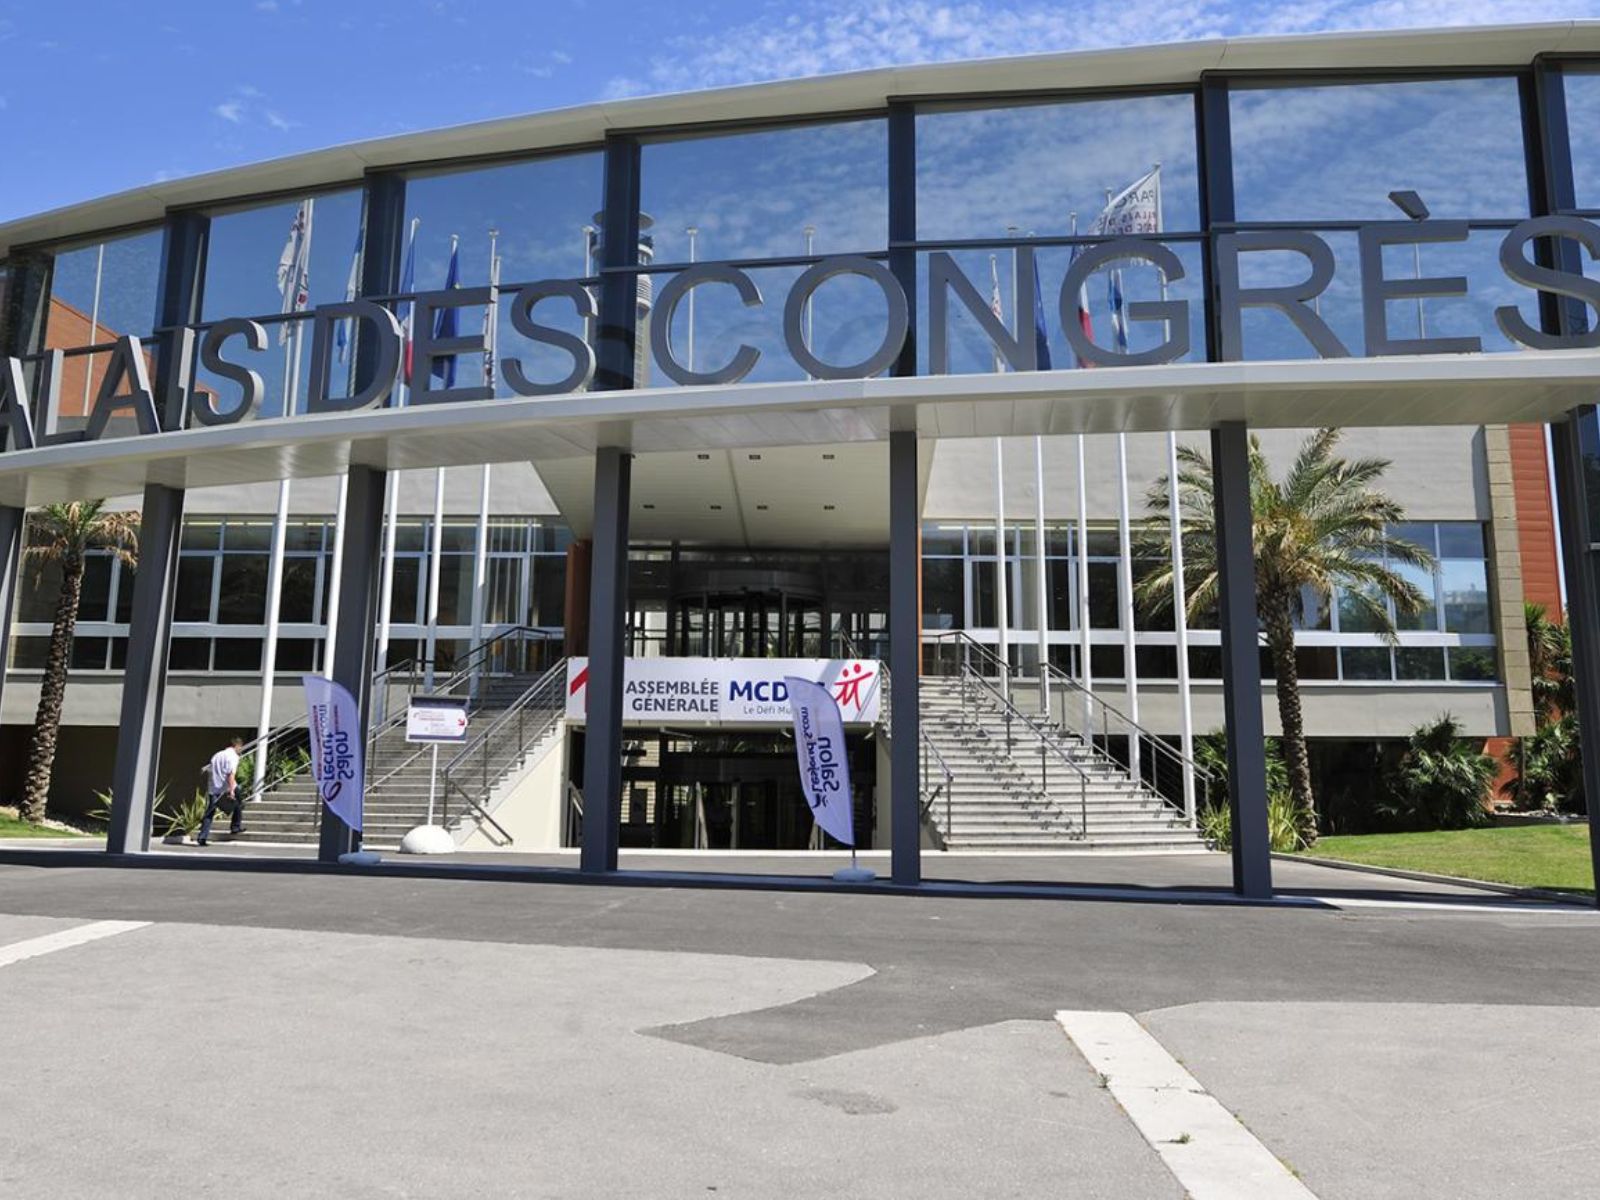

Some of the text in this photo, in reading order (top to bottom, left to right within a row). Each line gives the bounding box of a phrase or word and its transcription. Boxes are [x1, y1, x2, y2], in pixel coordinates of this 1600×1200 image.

[307, 279, 599, 412] DES
[650, 189, 1600, 387] CONGRÈS
[625, 678, 719, 695] ASSEMBLÉE
[631, 695, 719, 712] GÉNÉRALE
